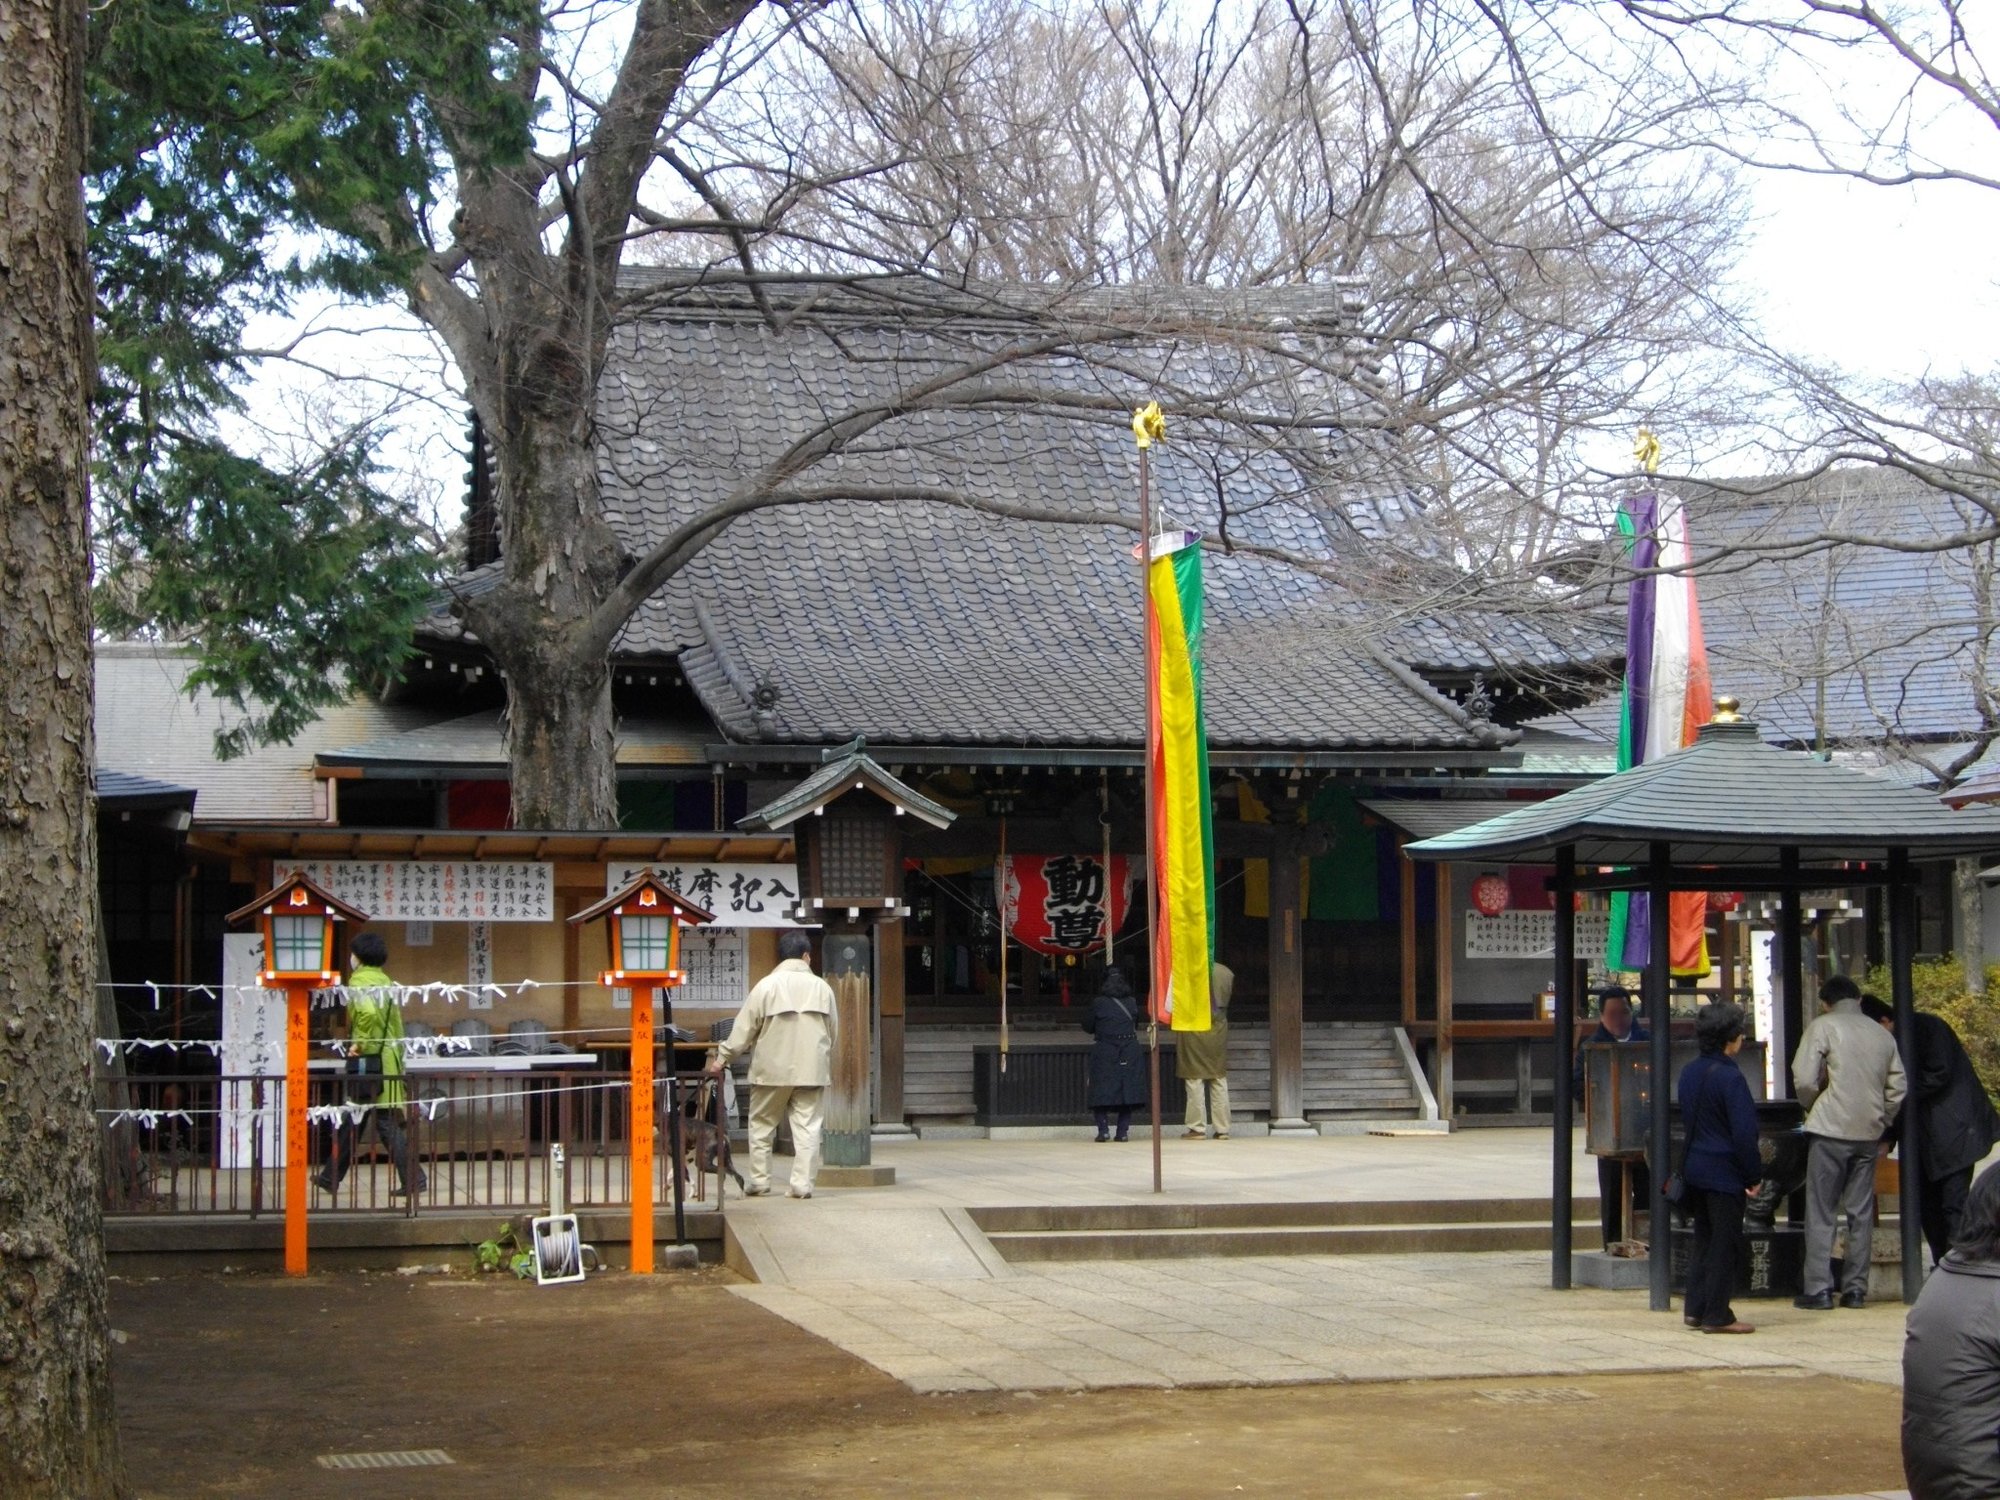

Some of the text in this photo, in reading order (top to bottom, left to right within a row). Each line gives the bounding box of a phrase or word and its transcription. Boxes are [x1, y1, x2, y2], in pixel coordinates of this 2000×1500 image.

[534, 866, 547, 918] 家内安全
[1042, 854, 1105, 948] 動尊
